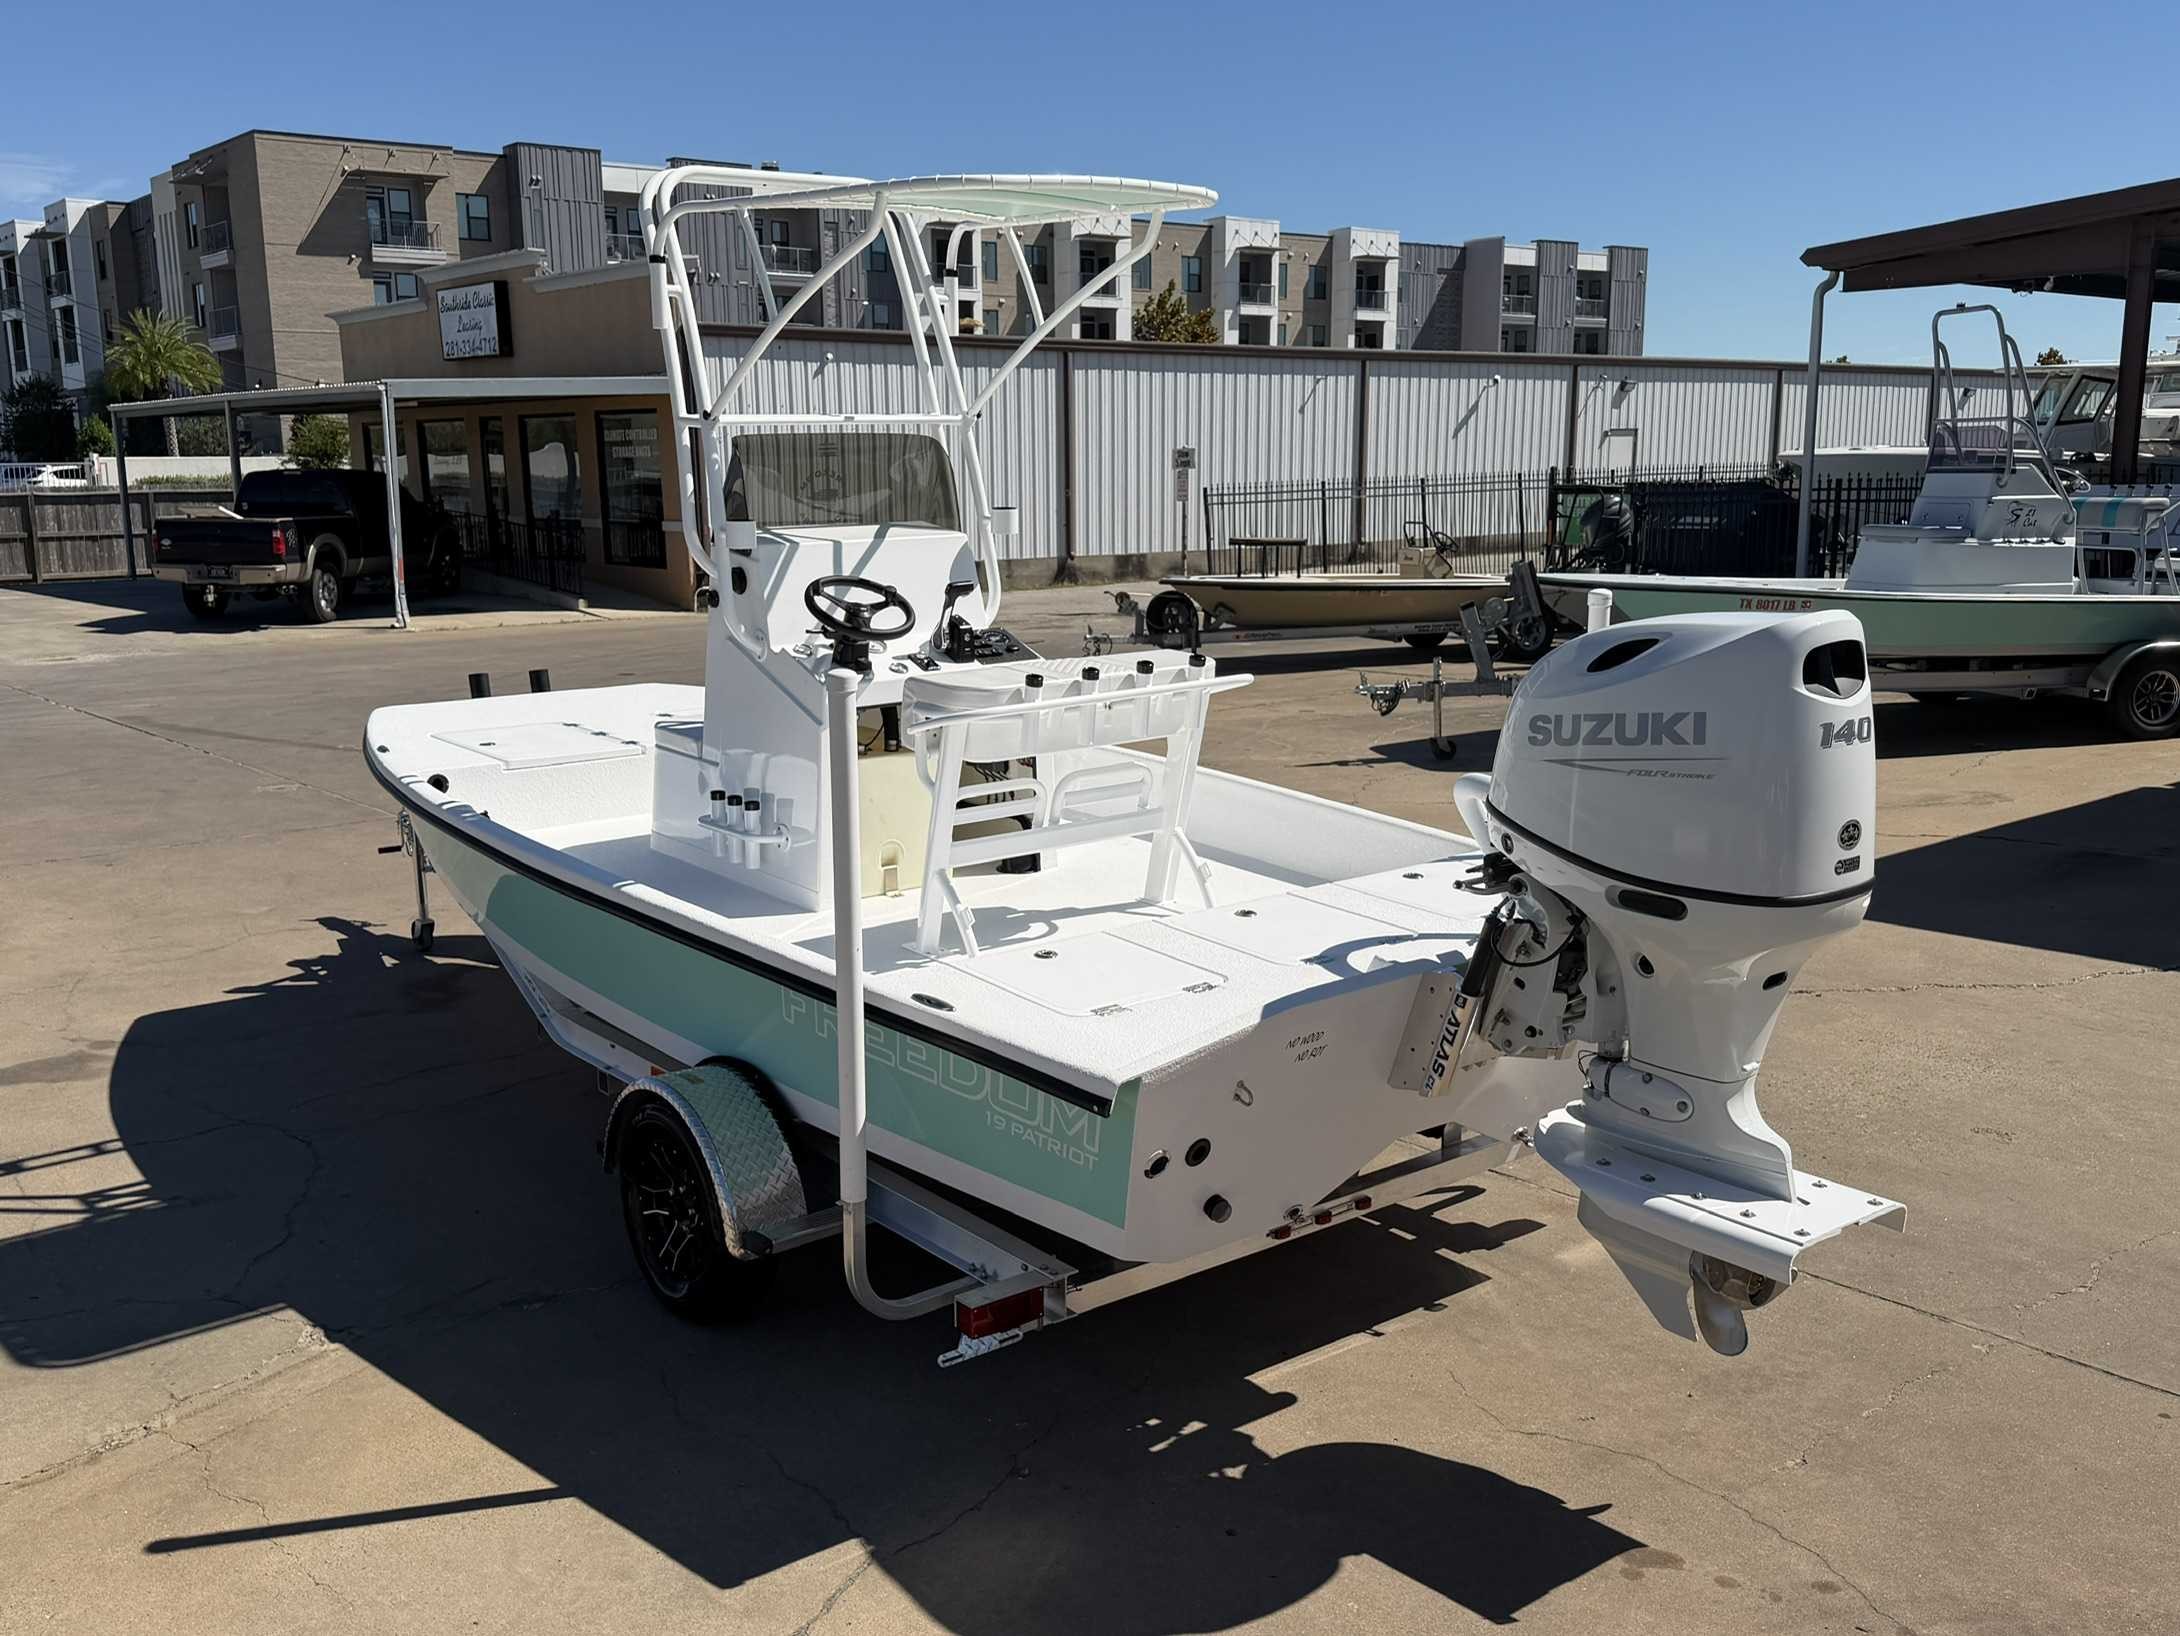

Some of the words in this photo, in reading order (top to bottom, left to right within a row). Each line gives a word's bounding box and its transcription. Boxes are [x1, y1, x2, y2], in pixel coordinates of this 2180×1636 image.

[456, 314, 483, 337] Leasing
[1740, 598, 1753, 609] TX
[1527, 711, 1707, 747] SUZUKI
[1819, 716, 1872, 750] 140
[1431, 1008, 1462, 1078] ATLAS
[984, 1110, 1007, 1130] 19
[1010, 1122, 1099, 1171] PATRIOT
